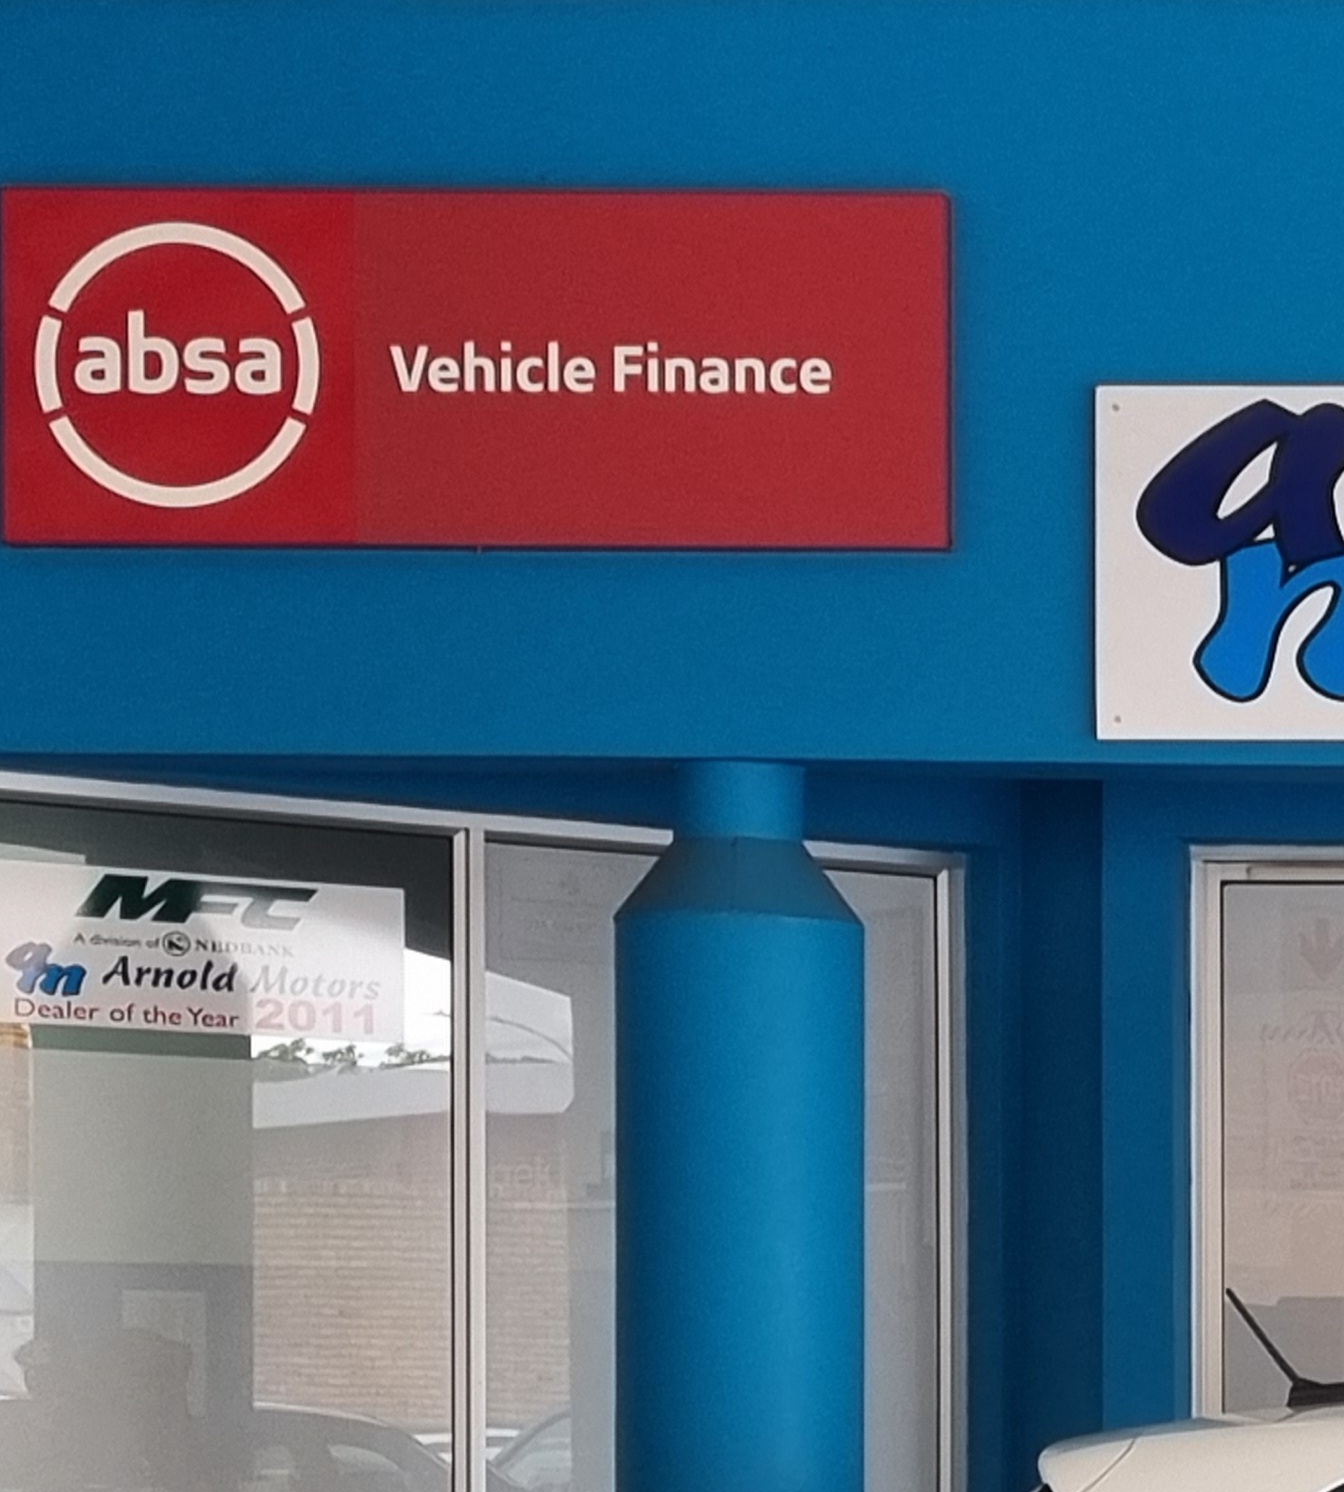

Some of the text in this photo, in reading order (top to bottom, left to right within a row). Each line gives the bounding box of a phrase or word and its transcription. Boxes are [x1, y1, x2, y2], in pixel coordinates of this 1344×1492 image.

[74, 310, 283, 395] absa
[390, 341, 833, 396] Vehicle Finance
[75, 873, 318, 931] MFC
[195, 937, 296, 958] NEDBANK
[102, 956, 382, 1000] Arnold Motors
[14, 998, 376, 1035] Dealer of the Year 2011
